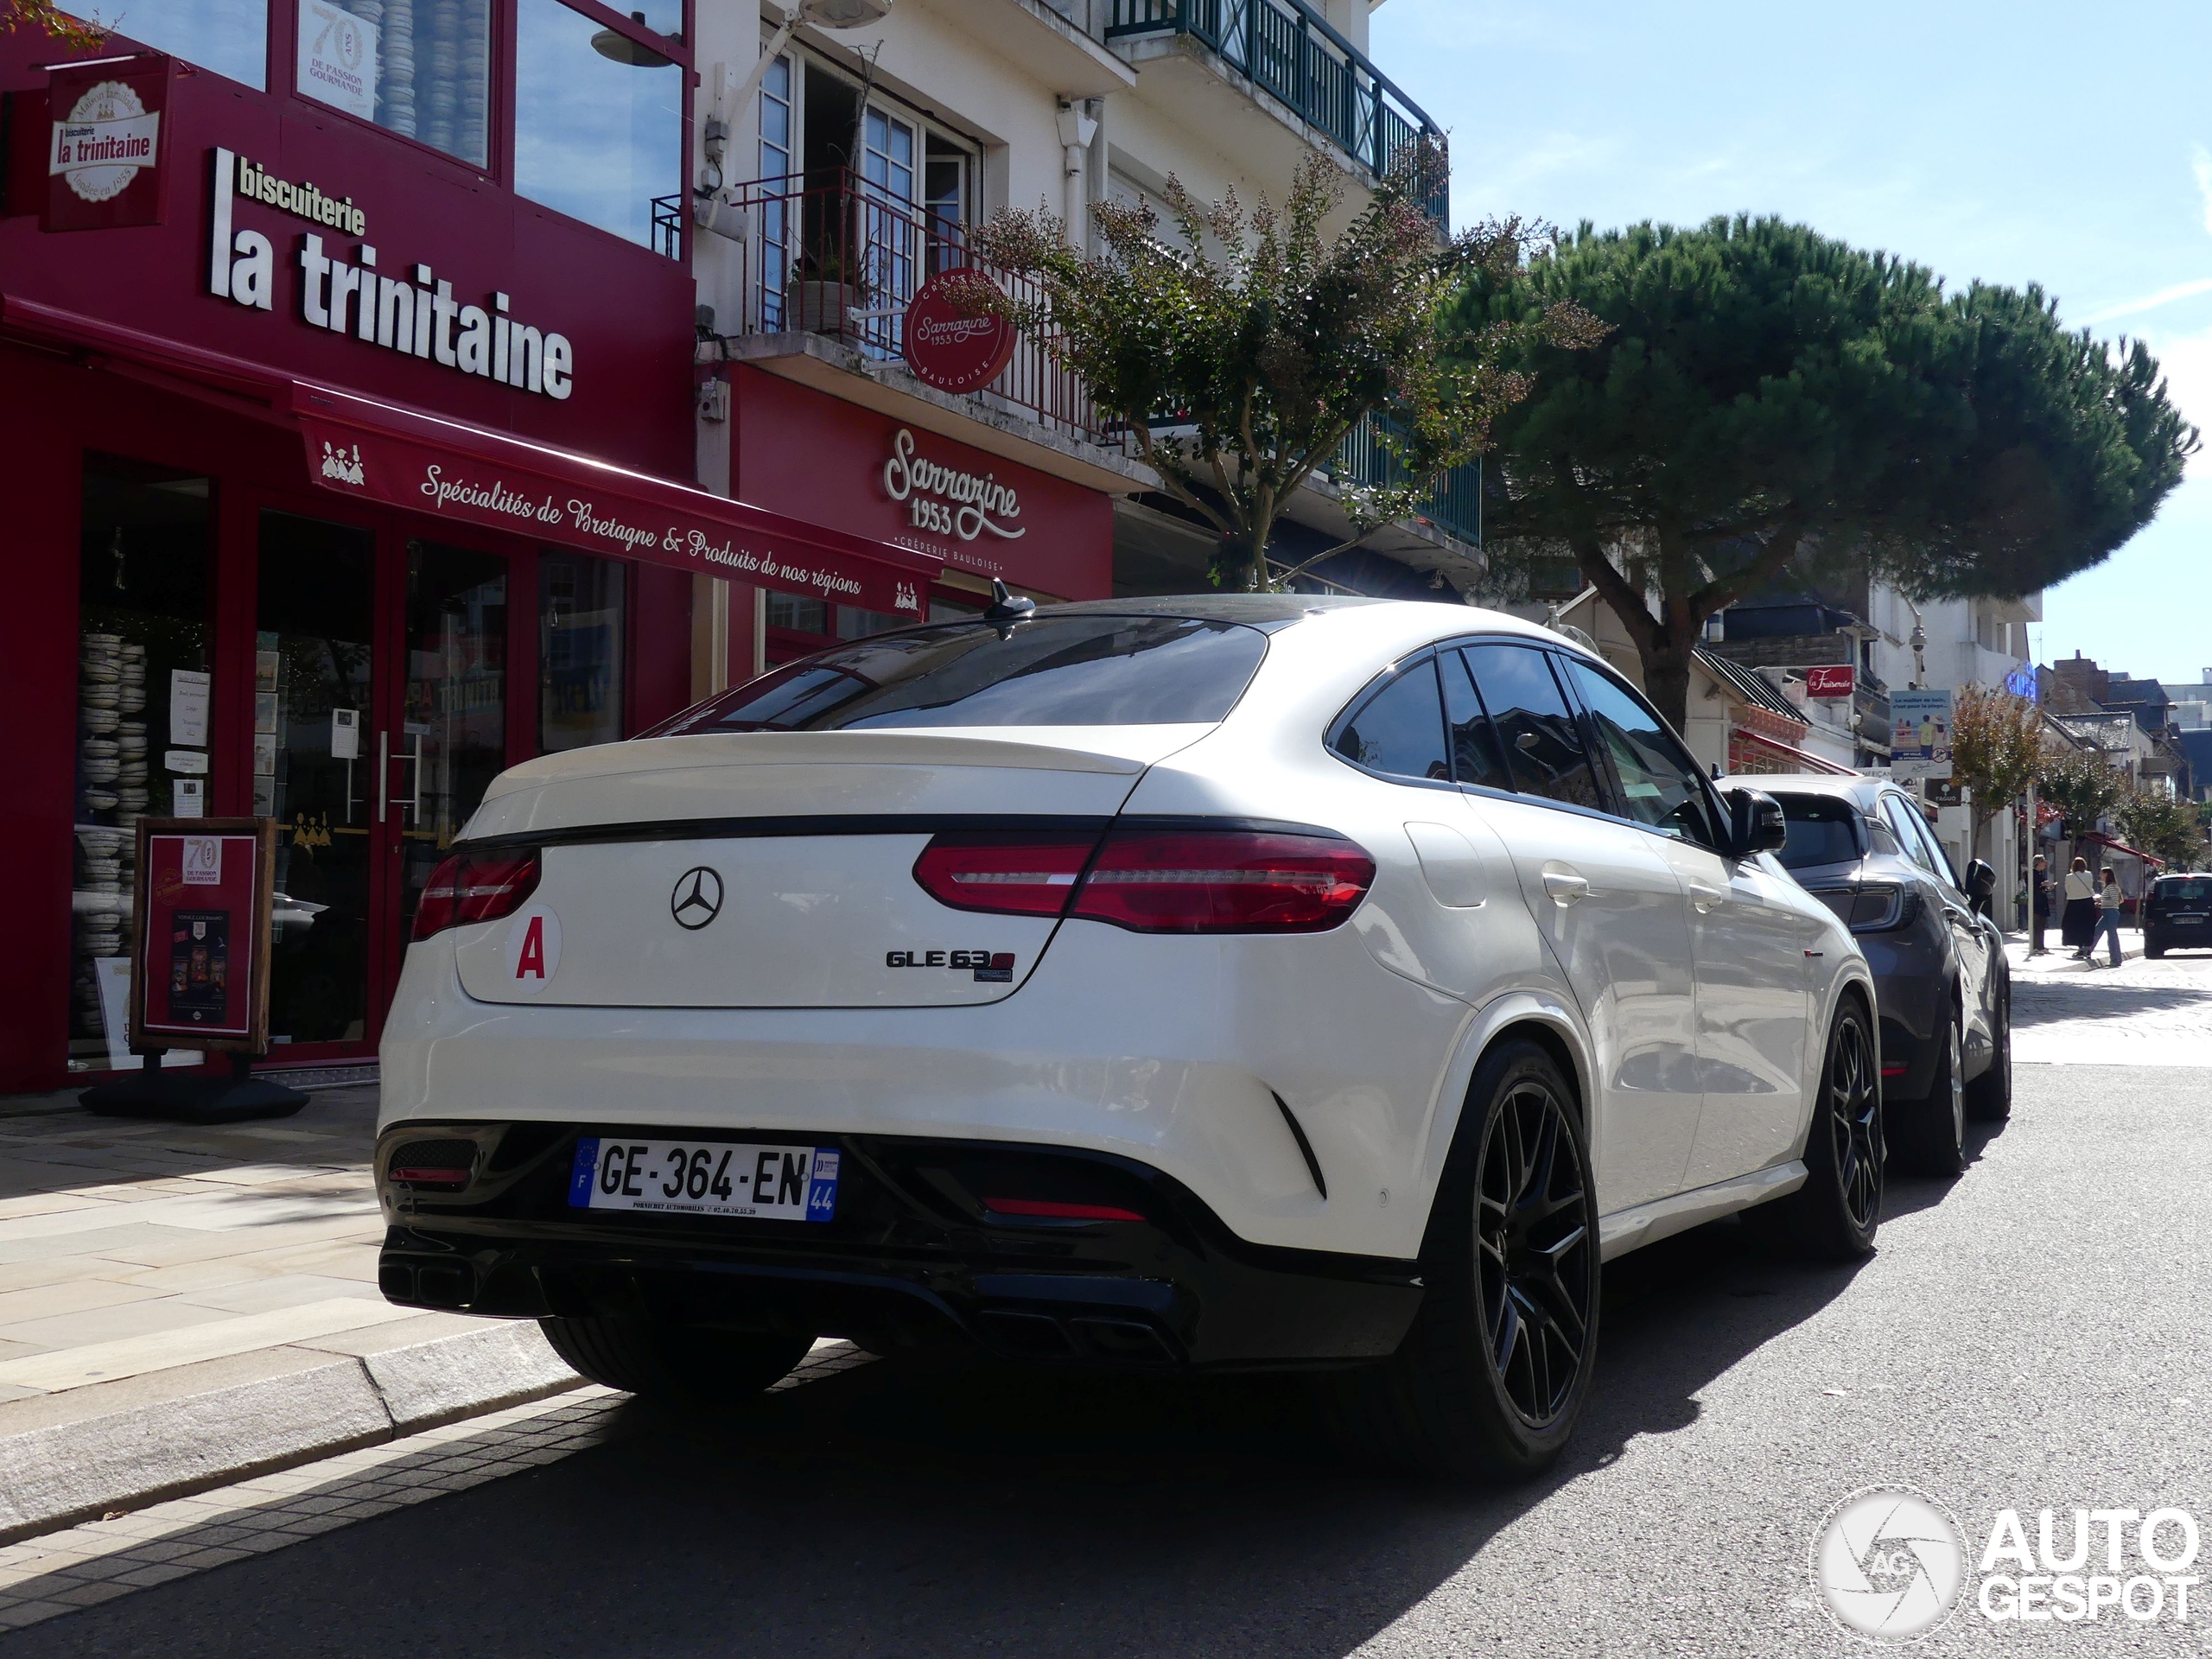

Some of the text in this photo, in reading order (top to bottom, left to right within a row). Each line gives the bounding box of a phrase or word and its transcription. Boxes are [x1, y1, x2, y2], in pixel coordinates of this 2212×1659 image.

[312, 5, 363, 70] 70
[309, 67, 363, 96] GOURMANDE
[312, 58, 363, 86] DE PASSION
[76, 88, 136, 119] Maison familiale
[57, 129, 150, 164] la trinitaine
[65, 126, 95, 137] biscuiterie
[100, 187, 111, 196] en
[239, 156, 365, 237] biscuiterie
[210, 146, 573, 400] la trinitaine
[917, 316, 995, 343] Sarrazine
[931, 334, 952, 346] 1953
[921, 360, 990, 386] BAULOISE
[884, 429, 1027, 541] Sarrazine
[421, 465, 862, 597] Spécialités de Bretagne & Produits de nos régions
[909, 498, 952, 536] 1953
[899, 537, 999, 572] CRÊPERIE BAULOISE
[188, 839, 217, 868] 70
[515, 916, 545, 979] A
[886, 950, 946, 968] GLE
[950, 950, 991, 969] 63
[578, 1175, 587, 1188] F
[601, 1145, 807, 1205] GE-364-EN
[810, 1185, 833, 1211] 44
